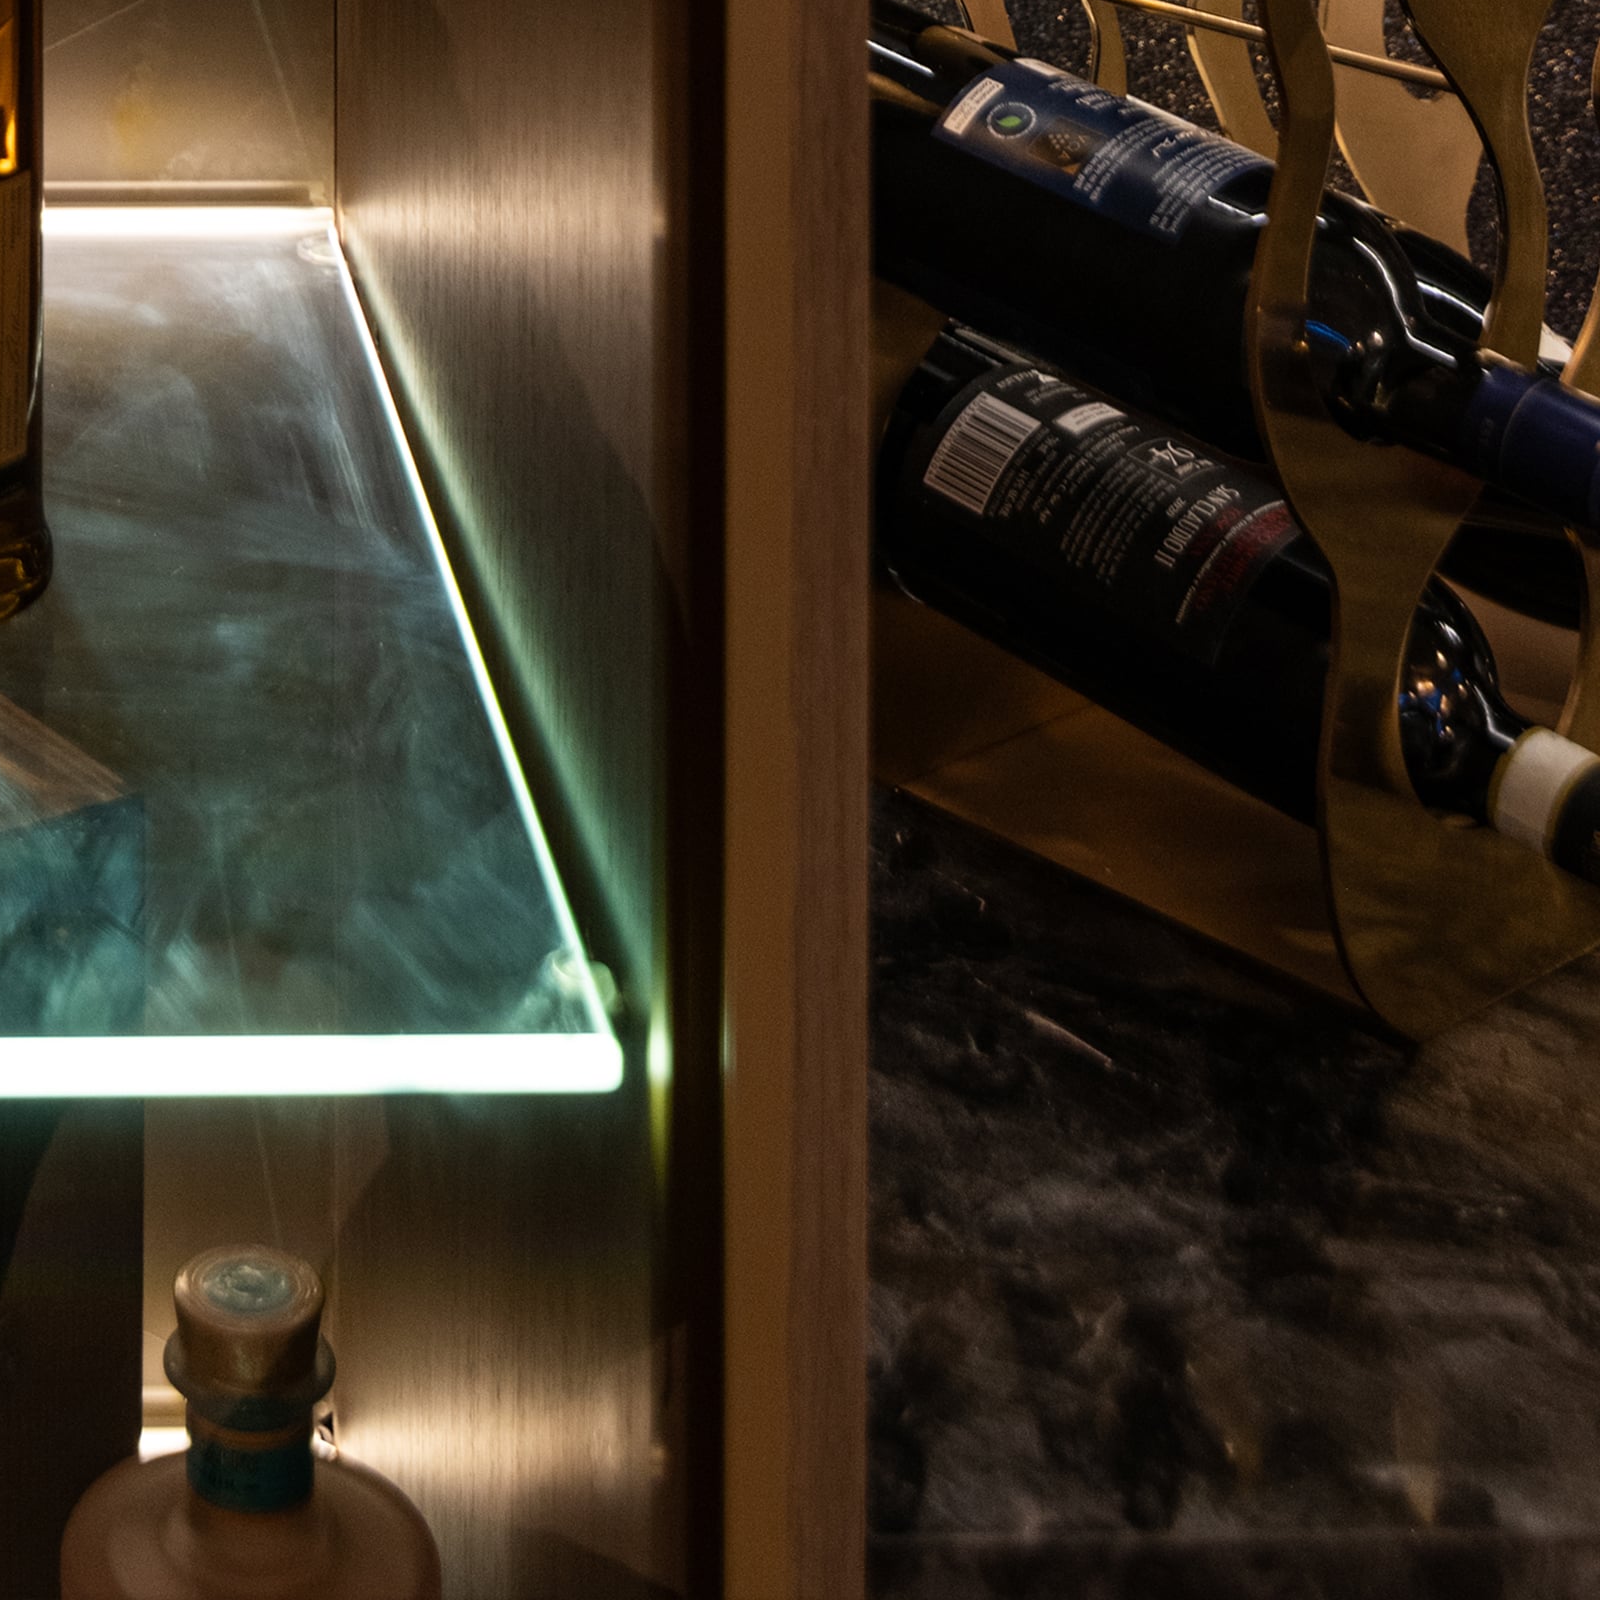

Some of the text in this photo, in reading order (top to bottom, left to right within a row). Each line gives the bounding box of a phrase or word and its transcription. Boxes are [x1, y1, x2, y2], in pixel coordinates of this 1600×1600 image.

[1147, 439, 1197, 469] 94
[1204, 482, 1244, 510] SAN
[1161, 498, 1220, 555] CLAUDIO
